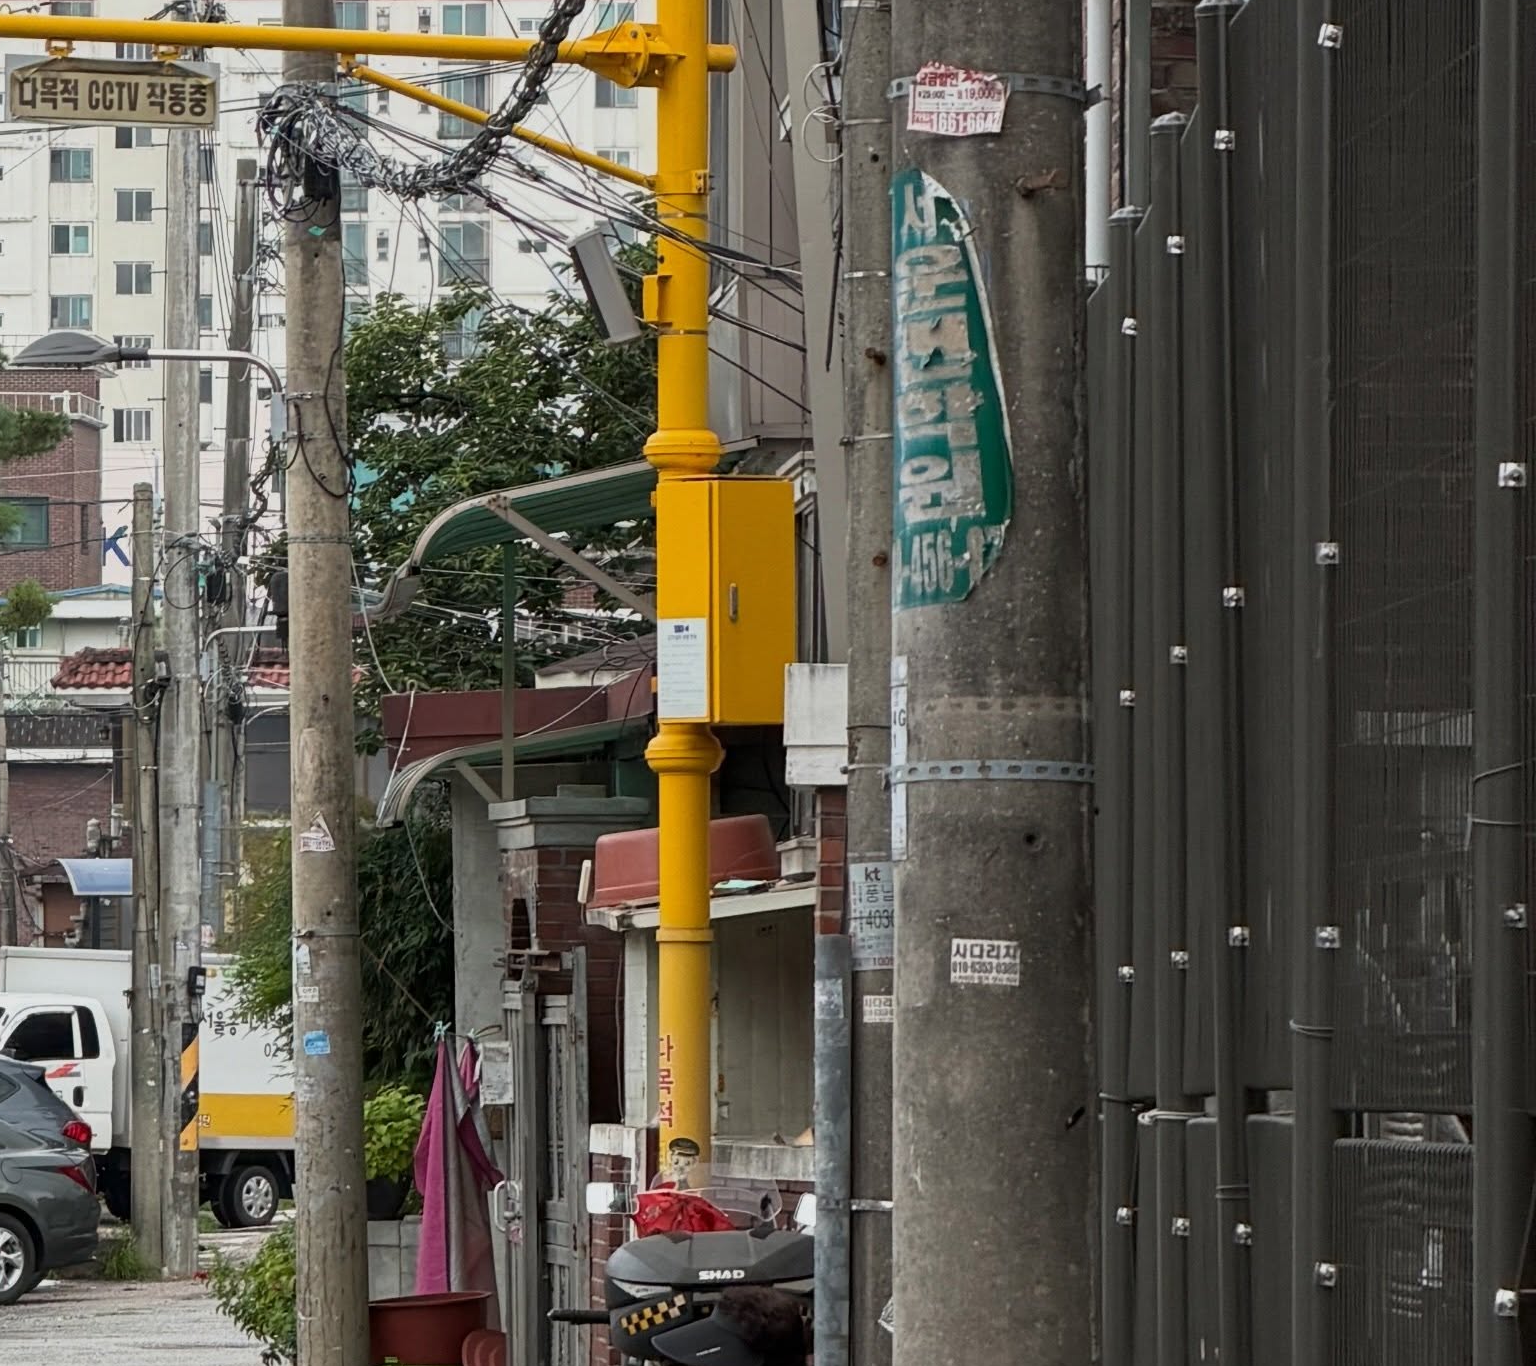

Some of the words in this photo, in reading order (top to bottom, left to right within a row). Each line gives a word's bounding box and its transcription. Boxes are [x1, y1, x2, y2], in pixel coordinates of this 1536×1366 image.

[19, 77, 79, 111] 다목적
[88, 80, 139, 111] CCTV
[146, 83, 207, 117] 작동중
[865, 866, 881, 882] kt
[659, 1035, 674, 1128] 다목적
[698, 1269, 745, 1280] SHAD
